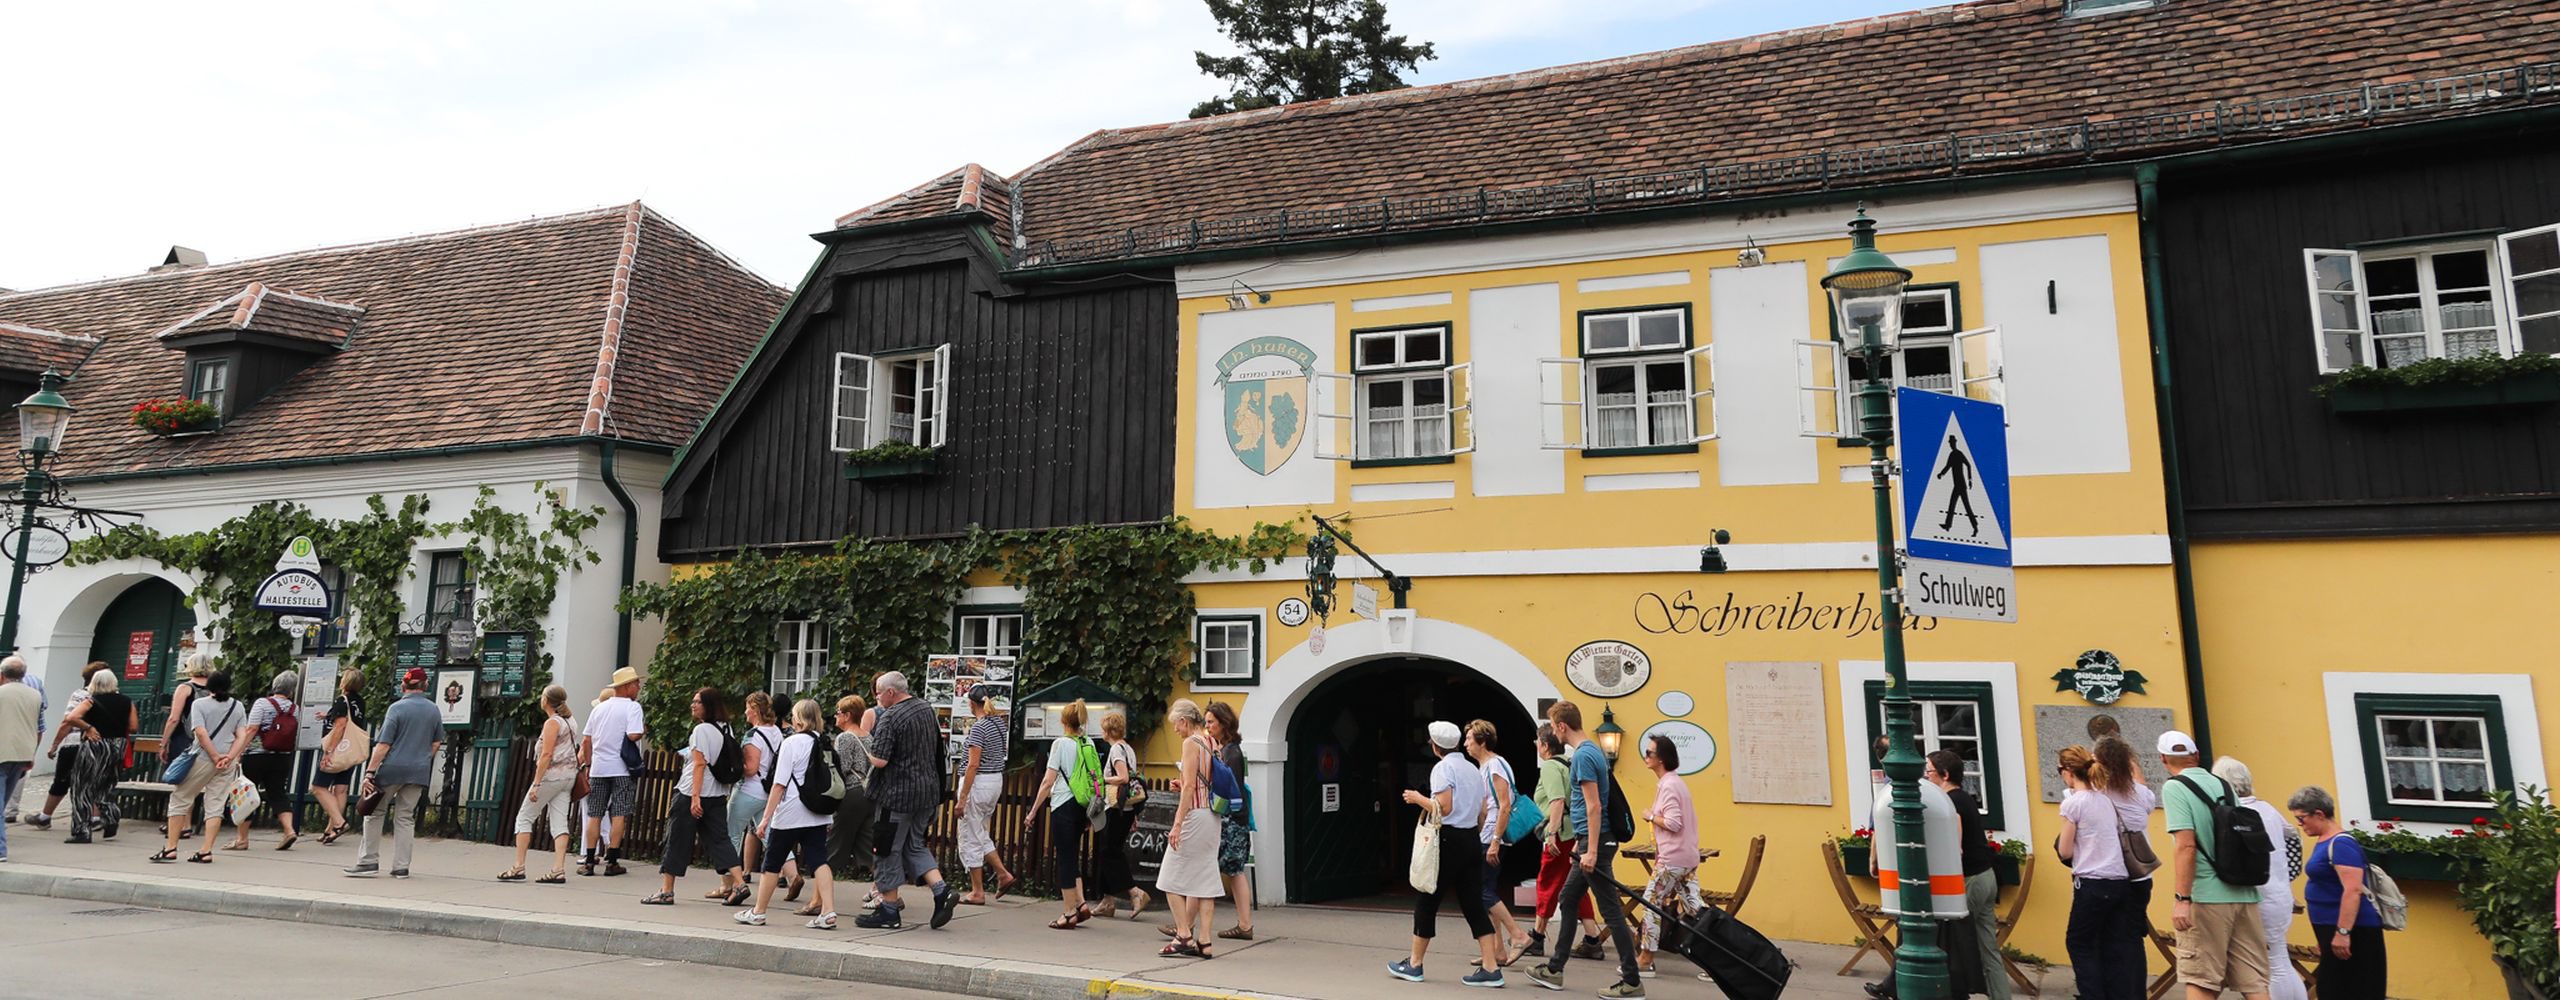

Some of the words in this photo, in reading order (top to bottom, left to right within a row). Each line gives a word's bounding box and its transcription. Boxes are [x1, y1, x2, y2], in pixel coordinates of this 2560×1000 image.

[276, 575, 317, 590] AUTOBUS
[265, 596, 321, 606] HALTESTELLE
[1920, 571, 2006, 616] Schulweg
[1284, 603, 1301, 615] 54
[1569, 653, 1584, 670] Alt
[1580, 645, 1613, 659] Wiener
[1613, 644, 1645, 666] Garten
